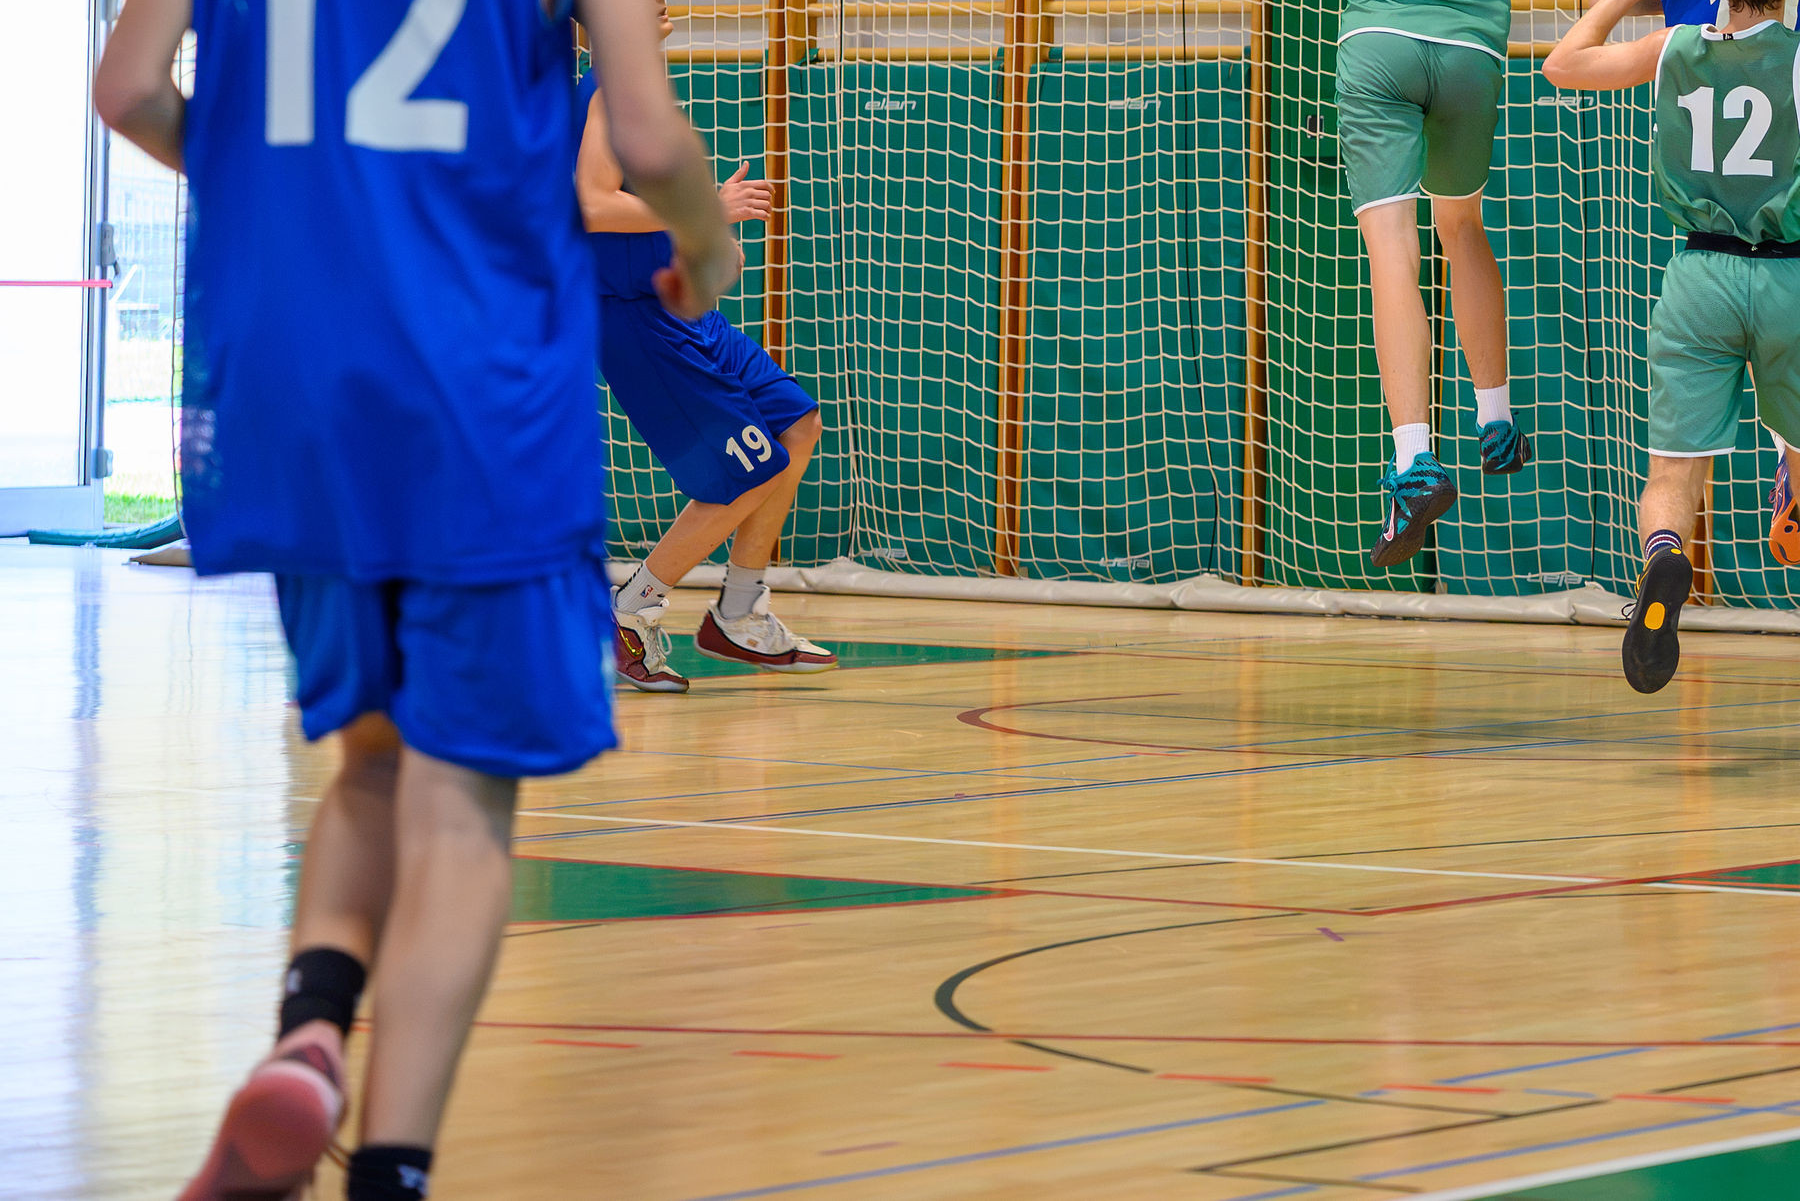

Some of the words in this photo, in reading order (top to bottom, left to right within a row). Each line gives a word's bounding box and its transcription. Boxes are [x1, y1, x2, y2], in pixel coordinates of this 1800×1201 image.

[865, 97, 916, 110] elan
[1677, 85, 1773, 177] 12
[725, 425, 772, 472] 19
